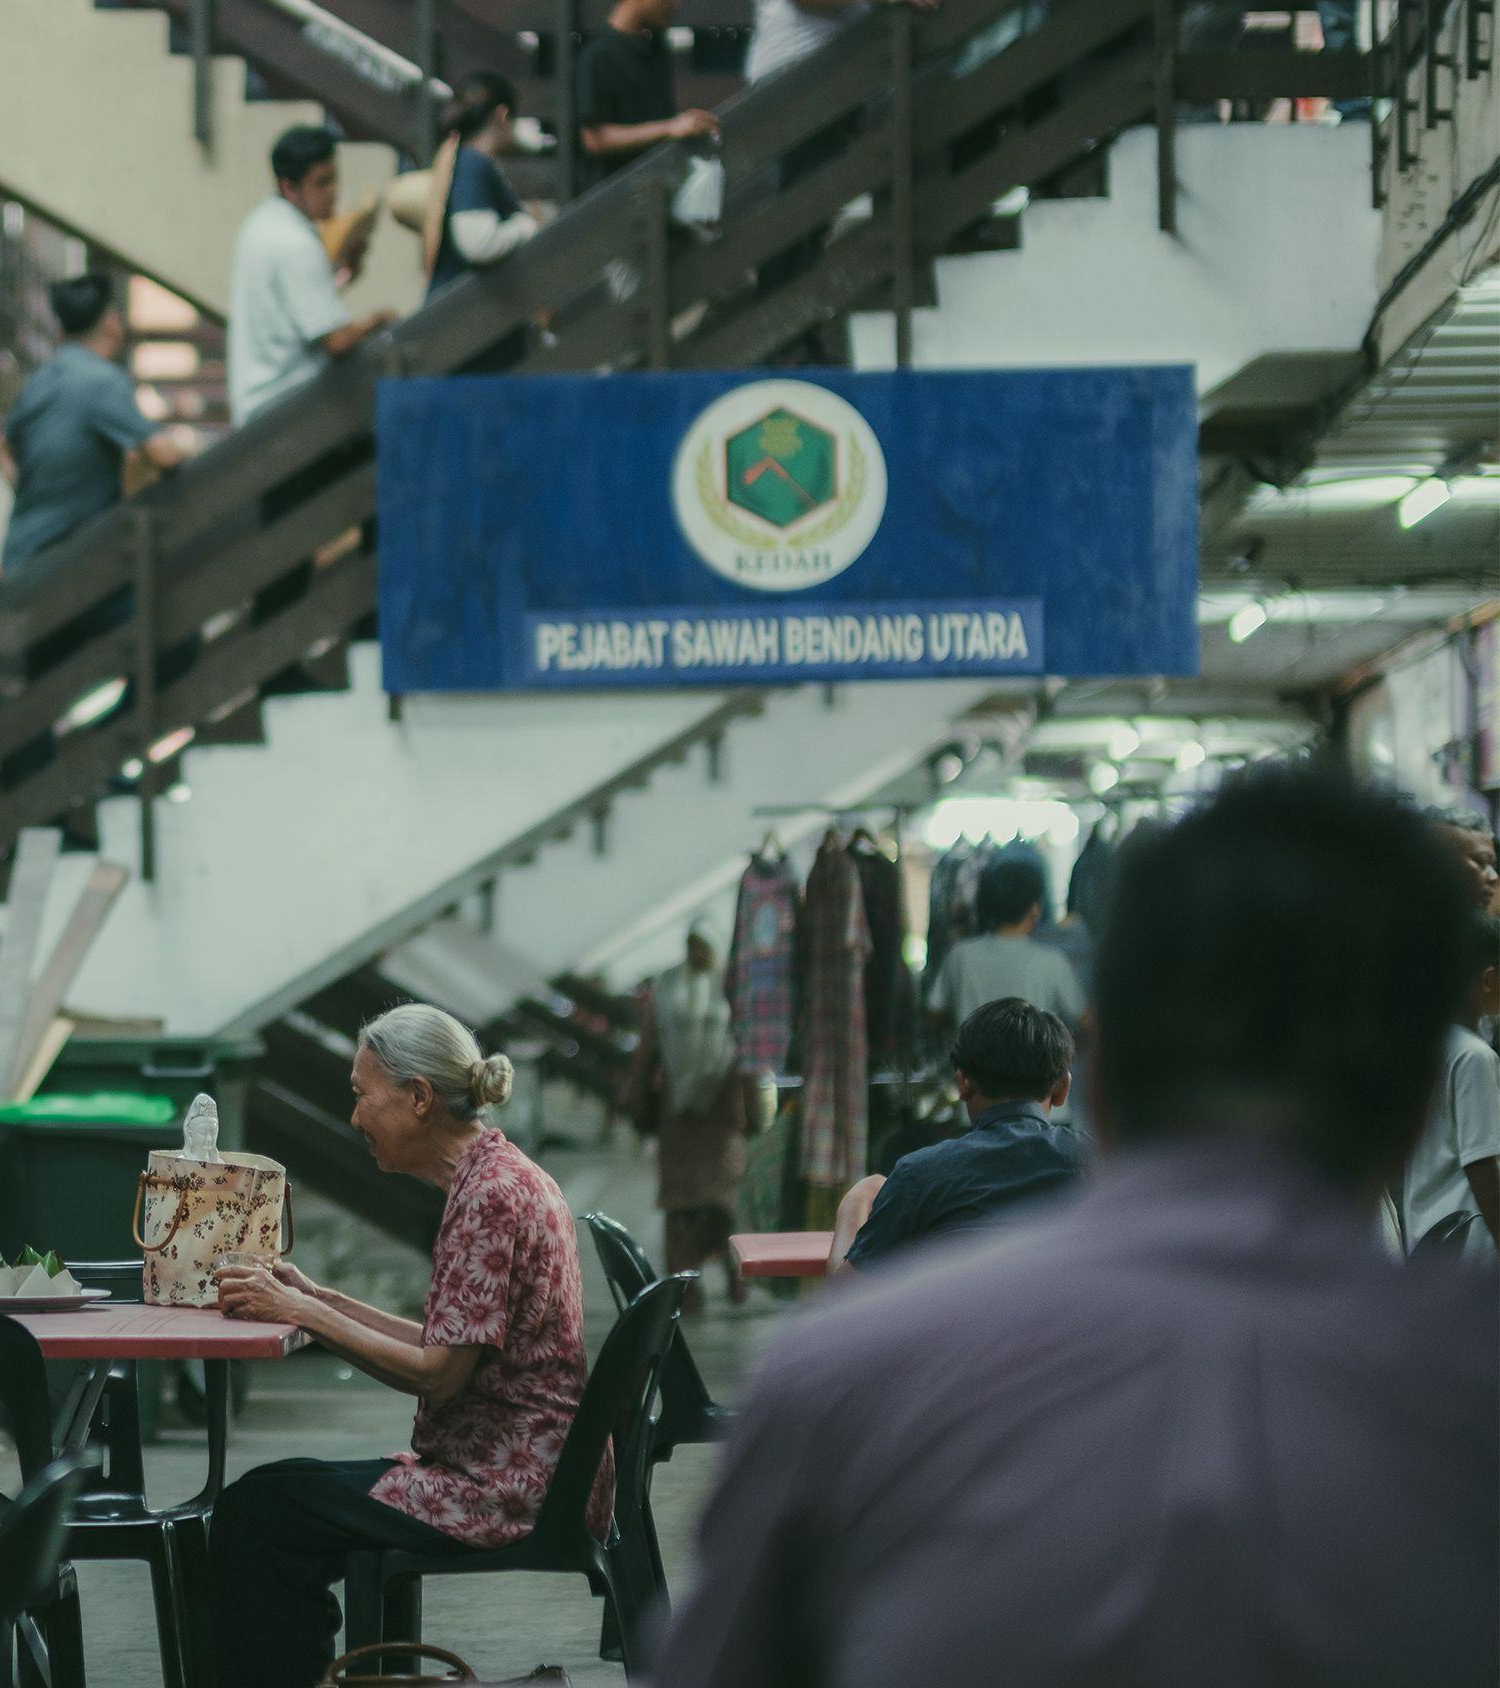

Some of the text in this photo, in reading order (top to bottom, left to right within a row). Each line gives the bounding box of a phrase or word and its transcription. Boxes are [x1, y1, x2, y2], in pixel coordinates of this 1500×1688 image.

[736, 549, 832, 572] KEDAH
[537, 611, 1029, 671] PEJABAT SAWAH BENDANG UTARA
